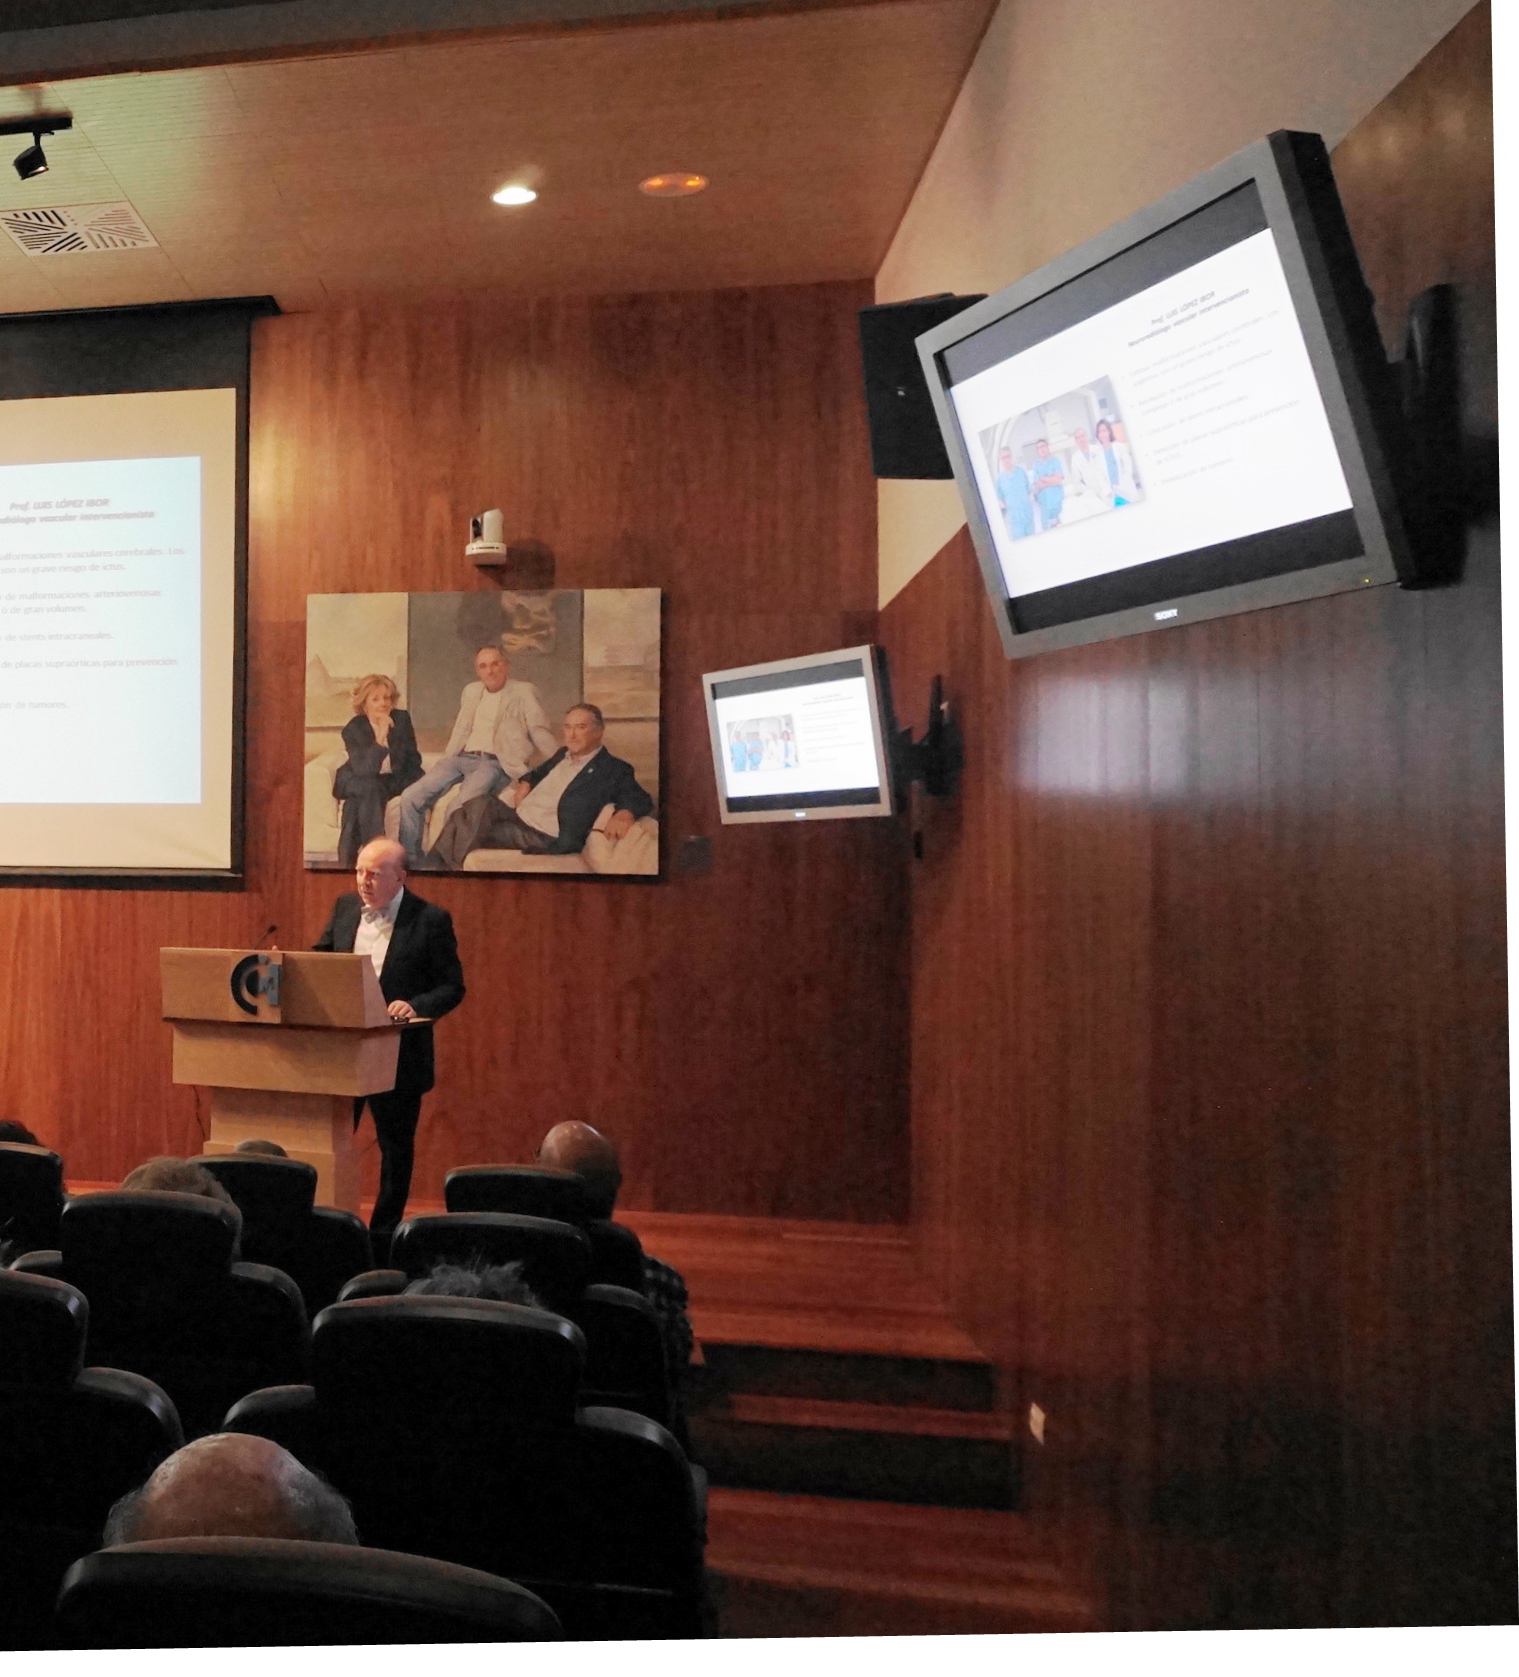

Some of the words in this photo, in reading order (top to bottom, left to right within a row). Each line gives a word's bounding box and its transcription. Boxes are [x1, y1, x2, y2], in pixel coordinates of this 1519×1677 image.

[10, 502, 30, 511] Prof.
[33, 501, 52, 509] LUIS
[86, 498, 109, 507] IBOR
[40, 514, 77, 523] vascular
[80, 511, 155, 521] intervencionista
[66, 549, 113, 559] vasculares
[168, 547, 184, 555] Los
[15, 660, 42, 670] placas
[103, 659, 124, 668] para
[126, 658, 177, 668] prevención
